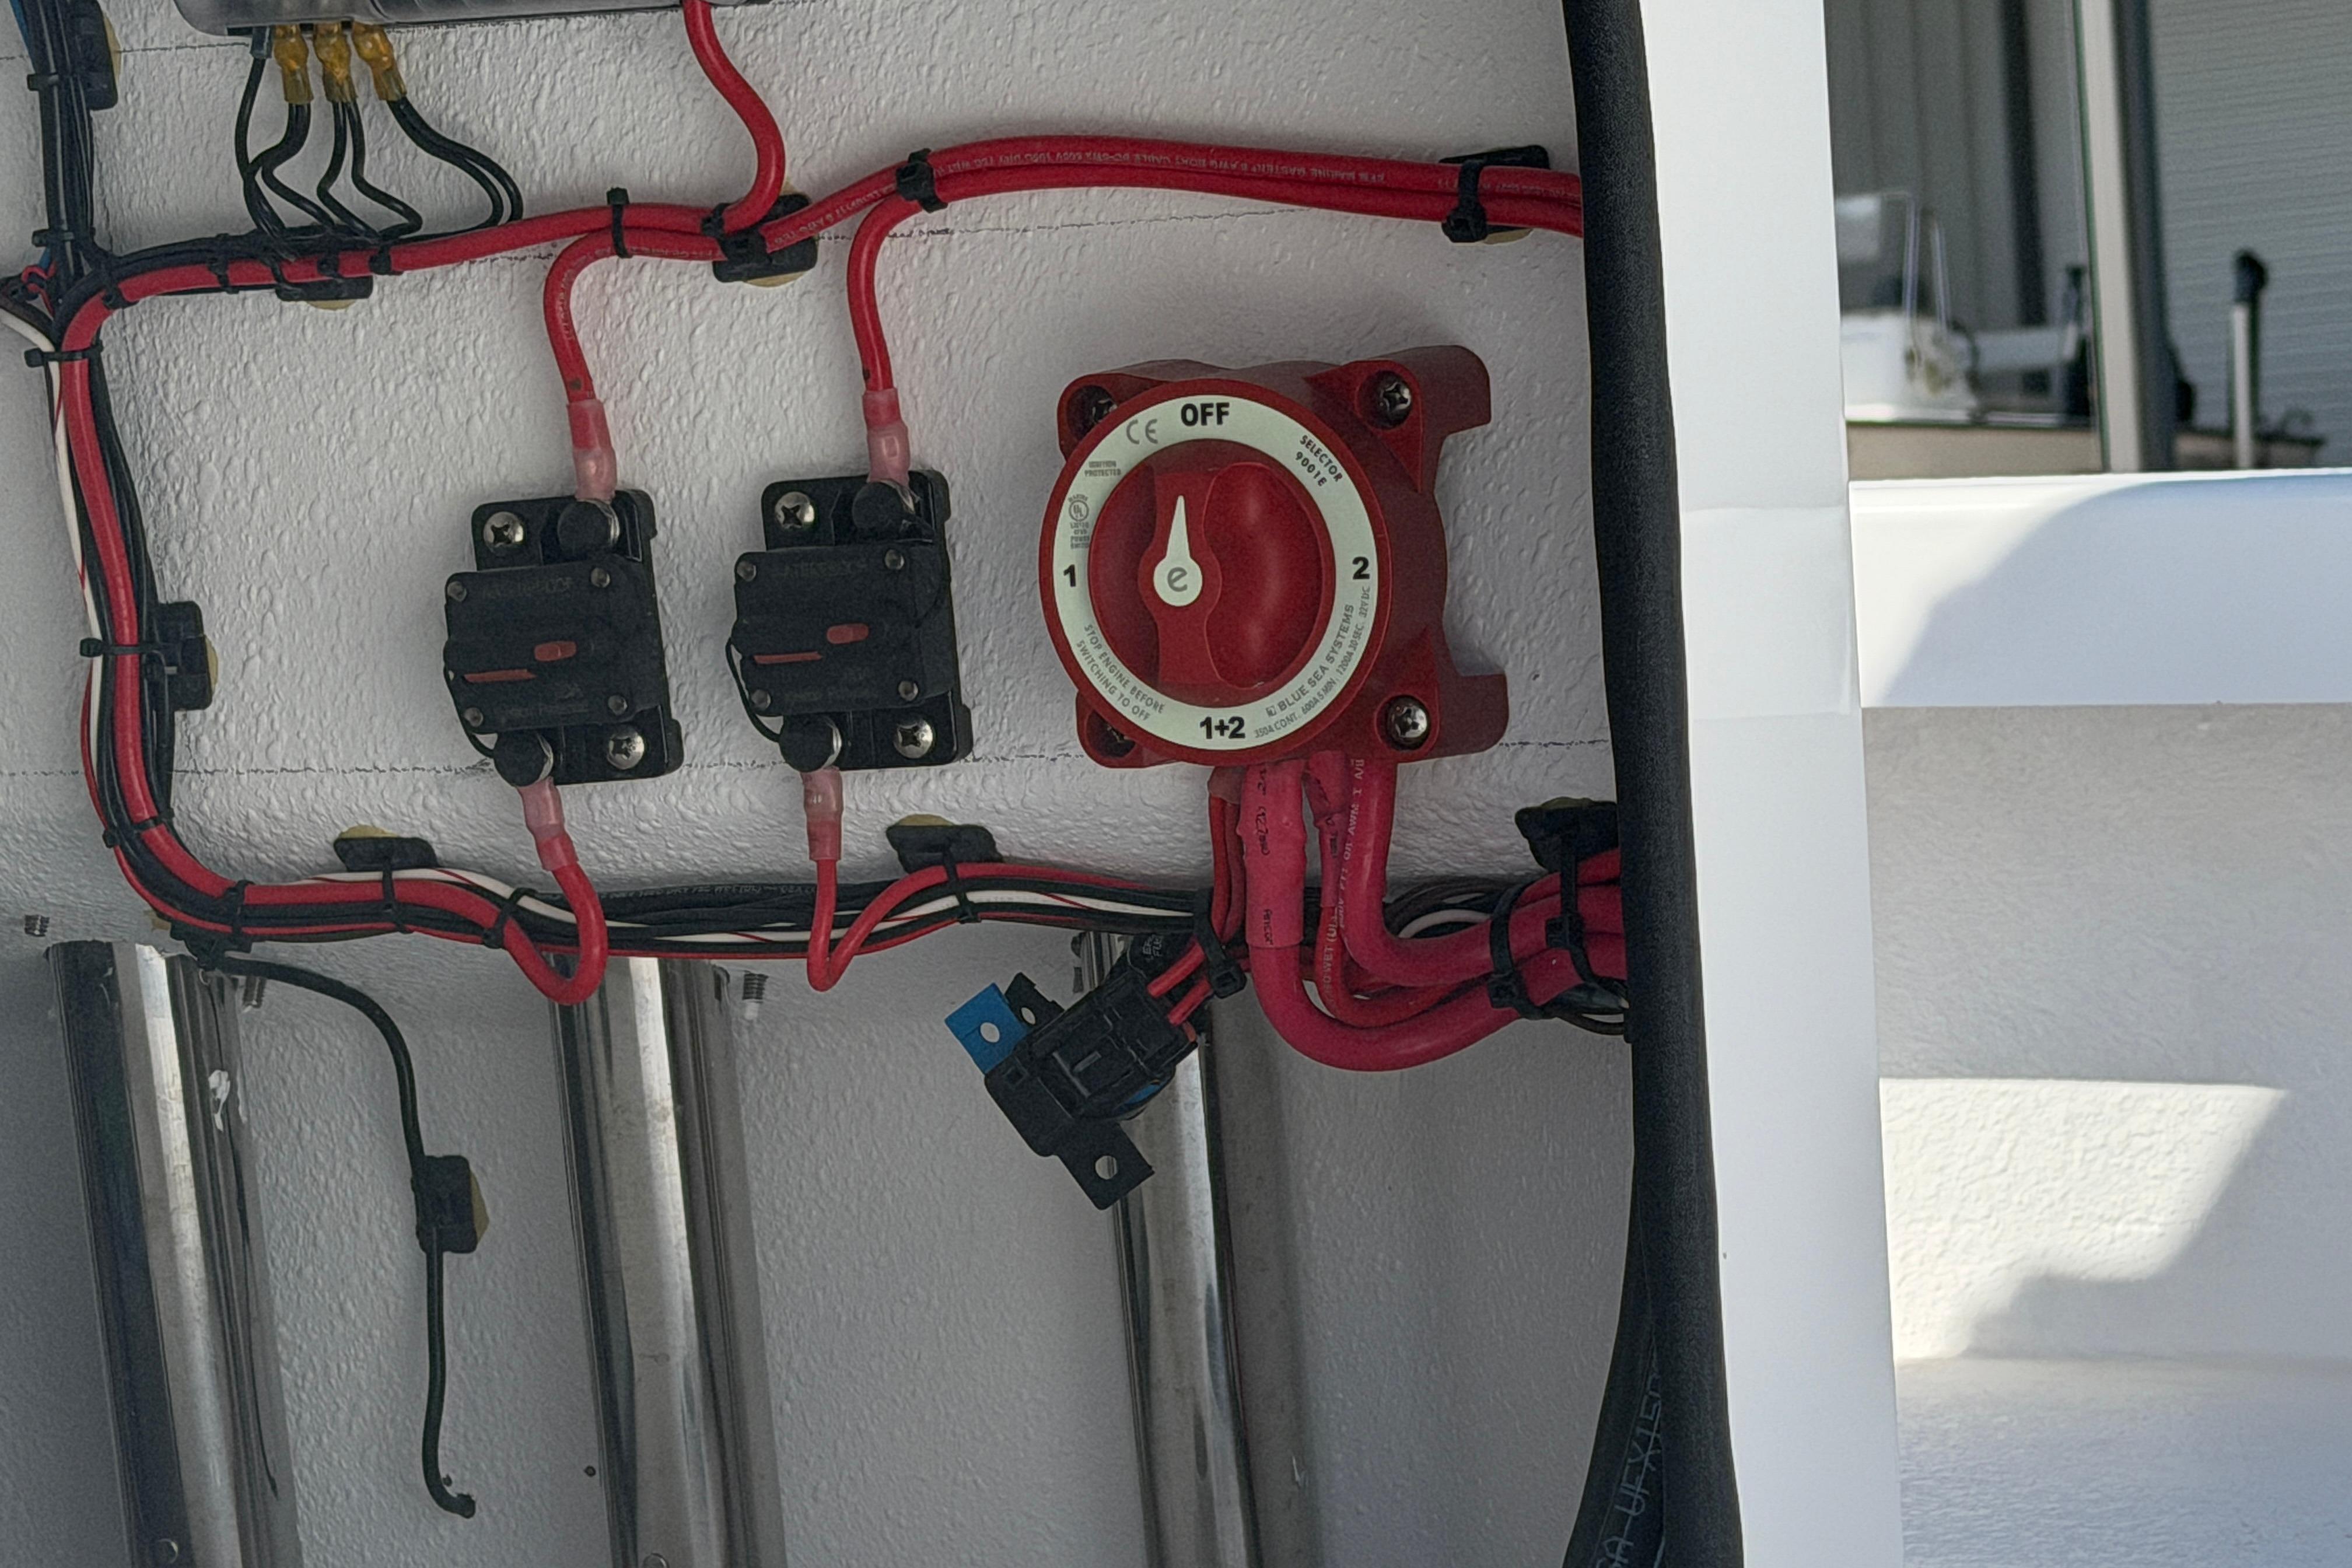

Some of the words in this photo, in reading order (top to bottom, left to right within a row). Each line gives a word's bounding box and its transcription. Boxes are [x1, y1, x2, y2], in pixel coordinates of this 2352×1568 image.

[1181, 402, 1230, 426] OFF
[1126, 418, 1158, 444] CE
[1296, 452, 1327, 487] 9001E
[1300, 435, 1343, 482] SELECTOR
[1084, 468, 1121, 477] PROTECTED
[1063, 564, 1076, 587] 1
[1167, 566, 1188, 592] e
[1352, 556, 1370, 580] 2
[1084, 624, 1102, 650] STOP
[1098, 652, 1130, 688] ENGINE
[1129, 685, 1166, 714] BEFORE
[1278, 684, 1309, 712] BLUE
[1307, 664, 1329, 688] SEA
[1325, 604, 1354, 664] SYSTEMS
[1076, 639, 1117, 695] SWITCHING
[1118, 692, 1130, 707] TO
[1132, 705, 1151, 721] OFF
[1200, 716, 1245, 739] 1+2
